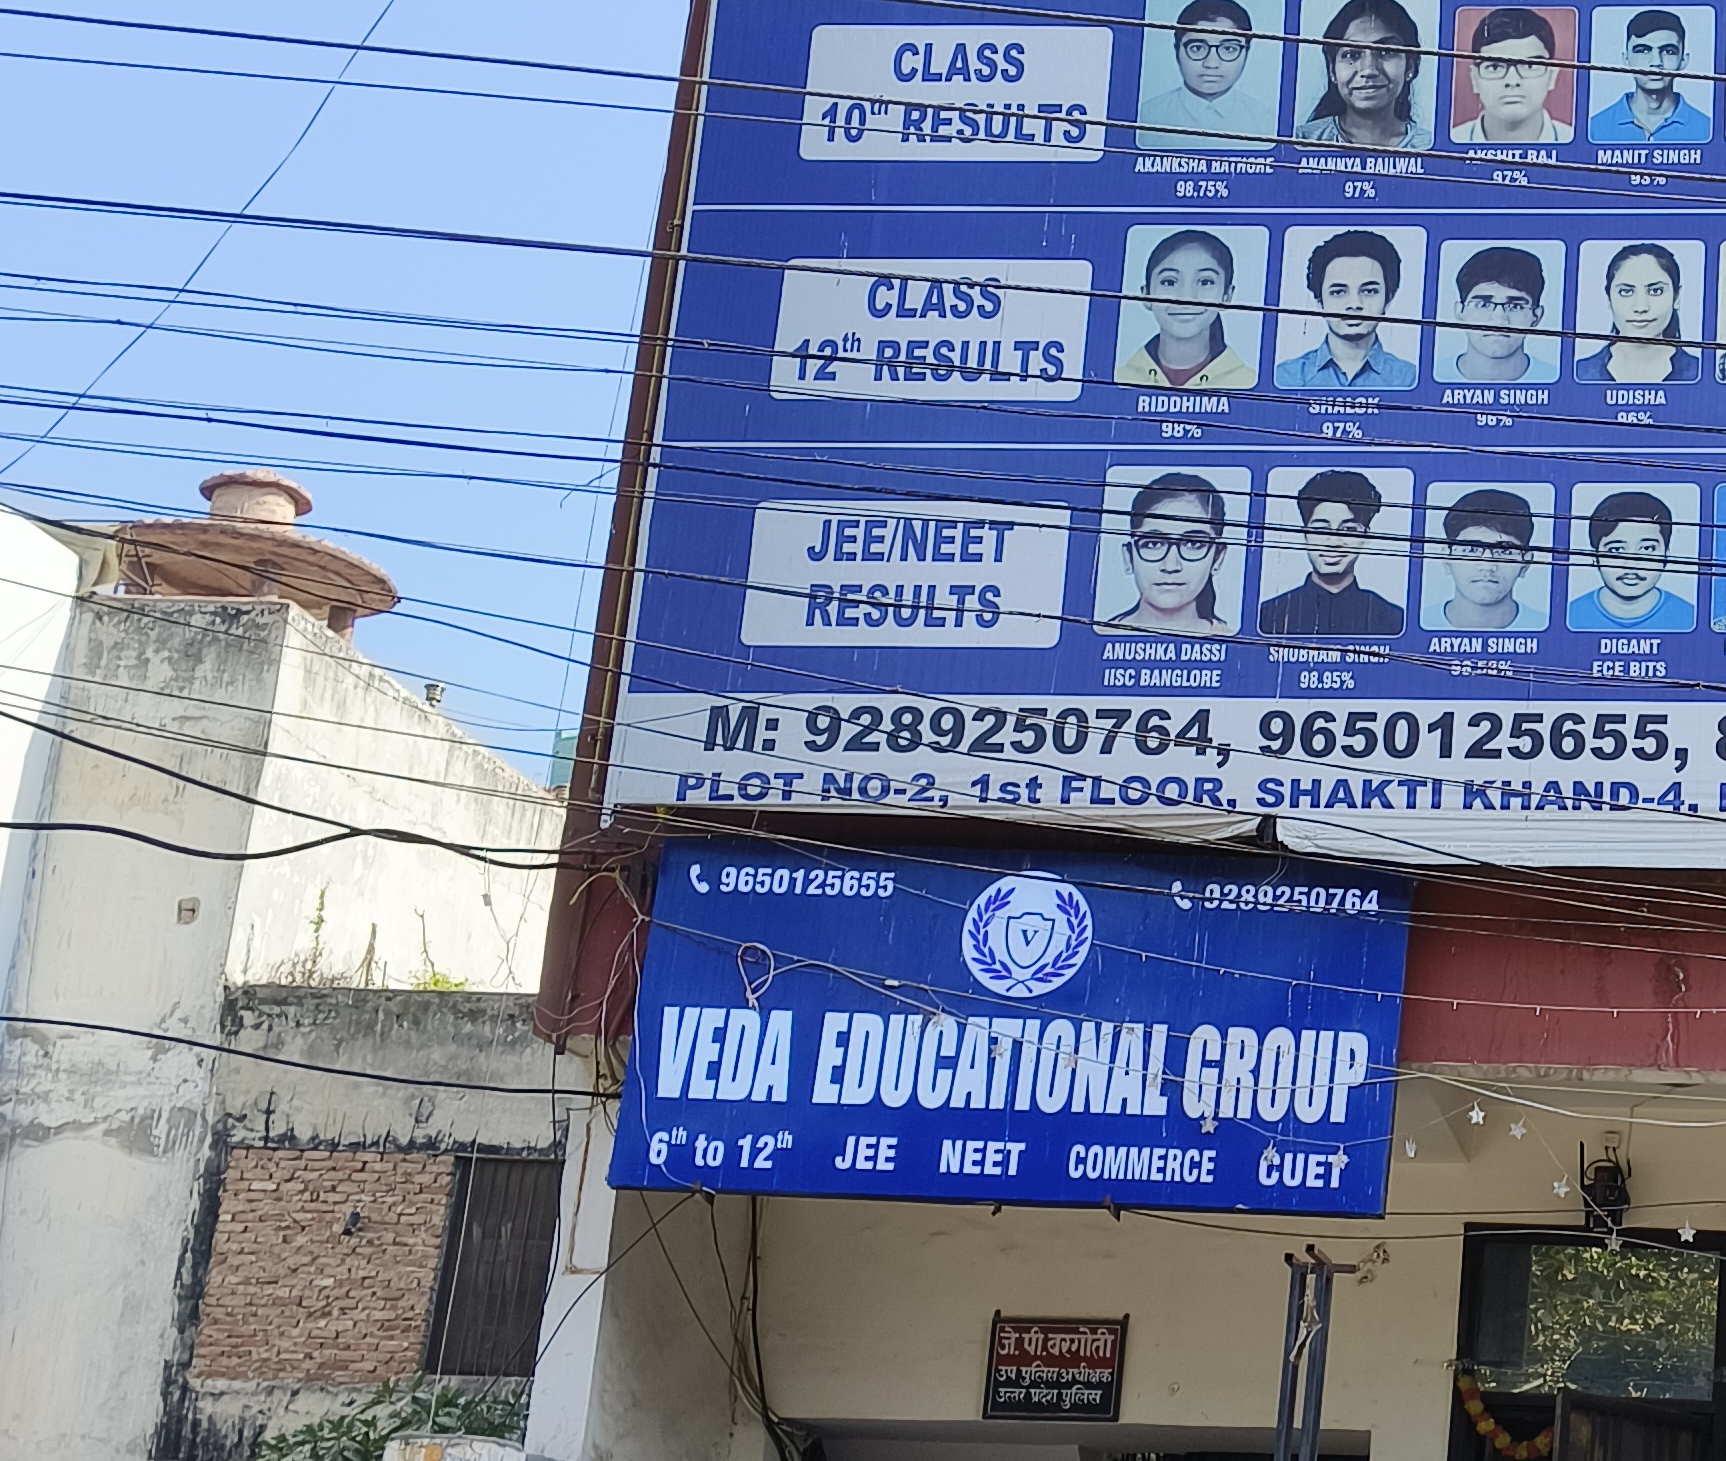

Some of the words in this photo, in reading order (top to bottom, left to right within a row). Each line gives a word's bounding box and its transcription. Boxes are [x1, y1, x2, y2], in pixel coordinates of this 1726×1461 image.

[893, 42, 1026, 83] CLASS
[900, 102, 1088, 145] RESULTS
[1597, 149, 1650, 165] MANIT
[1652, 148, 1702, 165] SINGH
[1175, 180, 1230, 199] 98.75%
[1343, 180, 1376, 198] 97%
[866, 277, 1002, 319] CLASS
[791, 331, 862, 383] 12th
[872, 338, 1066, 383] RESULTS
[1137, 395, 1230, 413] RIDDHIMA
[1441, 390, 1495, 405] ARYAN
[1499, 389, 1550, 405] SINGH
[1605, 390, 1667, 406] UDISHA
[1321, 421, 1363, 439] 97%
[806, 518, 1015, 564] JEE/NEET
[804, 584, 1003, 629] RESULTS
[1102, 643, 1177, 661] ANUSHKA
[1428, 637, 1482, 654] ARYAN
[1487, 637, 1538, 653] SINGH
[1600, 638, 1661, 655] DIGANT
[1139, 669, 1222, 687] BANGLORE
[1629, 661, 1667, 678] BITS
[702, 704, 780, 753] M:
[804, 704, 1231, 770] 9289250764,
[1256, 710, 1690, 774] 9650125655,
[674, 771, 810, 803] PLOT
[820, 771, 949, 808] NO-2,
[970, 771, 1042, 806] 1st
[1059, 774, 1238, 814] FLOOR,
[1255, 776, 1443, 811] SHAKTI
[719, 866, 897, 898] 9650125655
[1203, 883, 1380, 915] 9289250764
[655, 1005, 794, 1102] VEDA
[811, 1010, 1169, 1117] EDUCATIONAL
[1181, 1023, 1370, 1124] GROUP
[648, 1126, 688, 1165] 6th
[694, 1132, 725, 1167] to
[736, 1130, 794, 1169] 12th
[834, 1135, 899, 1170] JEE
[938, 1138, 1027, 1176] NEET
[1068, 1143, 1217, 1184] COMMERCE
[1257, 1151, 1348, 1189] CUET
